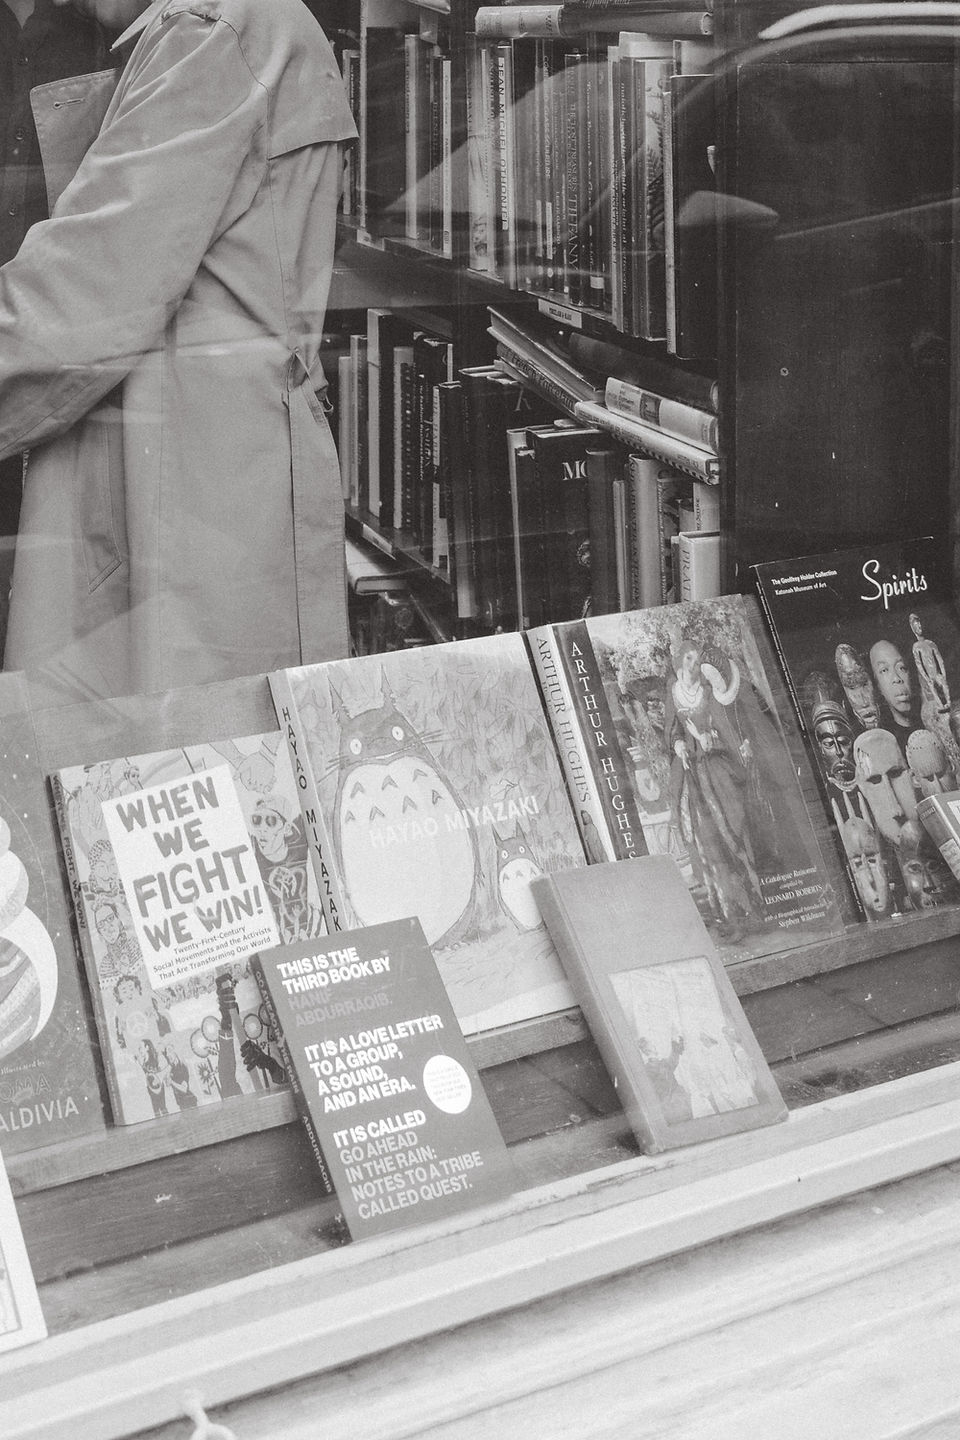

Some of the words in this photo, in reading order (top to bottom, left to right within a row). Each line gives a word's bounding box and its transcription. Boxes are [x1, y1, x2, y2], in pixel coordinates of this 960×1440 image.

[498, 64, 506, 96] JEAN
[499, 103, 507, 151] MICHEL
[771, 577, 781, 586] The
[814, 568, 838, 579] Collection
[793, 583, 813, 593] Museum
[819, 581, 827, 589] Art
[860, 559, 928, 610] Spirits
[571, 641, 607, 747] ARTHUR
[536, 637, 567, 714] ARTHUR
[558, 720, 591, 803] HUGHES
[115, 775, 221, 833] WHEN
[283, 707, 308, 790] HAYAO
[305, 809, 343, 932] MIYAZAK
[369, 816, 439, 849] HAYAO
[444, 795, 540, 833] MIYAZAKI
[153, 818, 210, 858] WE
[132, 844, 250, 918] FIGHT
[764, 890, 795, 905] LEONARD
[143, 912, 194, 953] WE
[192, 885, 264, 933] WIN!
[153, 957, 175, 972] Social
[175, 946, 215, 966] Movements
[215, 941, 229, 951] and
[229, 935, 242, 946] the
[242, 926, 272, 943] Activists
[159, 970, 175, 981] That
[176, 965, 188, 976] Are
[189, 949, 236, 971] Transforming
[236, 944, 249, 954] Our
[250, 936, 272, 950] World
[173, 925, 246, 956] Twenty-First-Century
[276, 956, 314, 979] THIS
[313, 953, 330, 971] IS
[327, 946, 360, 966] THE
[281, 970, 329, 995] THIRD
[328, 960, 374, 985] BOOK
[371, 956, 391, 975] BY
[289, 988, 333, 1011] HANIF
[304, 1043, 320, 1062] IT
[320, 1039, 338, 1058] IS
[339, 1036, 351, 1054] A
[348, 1026, 390, 1050] LOVE
[388, 1014, 444, 1041] LETTER
[309, 1059, 334, 1078] TO
[335, 1056, 348, 1073] A
[346, 1042, 403, 1069] GROUP,
[318, 1079, 331, 1096] A
[329, 1065, 389, 1092] SOUND,
[324, 1090, 357, 1114] AND
[358, 1083, 382, 1104] AN
[379, 1075, 417, 1098] ERA.
[332, 1129, 349, 1149] IT
[349, 1124, 368, 1144] IS
[367, 1109, 427, 1138] CALLED
[339, 1146, 365, 1165] GO
[366, 1131, 419, 1158] AHEAD
[344, 1164, 364, 1184] IN
[362, 1156, 397, 1178] THE
[395, 1144, 438, 1169] RAIN:
[350, 1172, 406, 1202] NOTES
[404, 1166, 428, 1185] TO
[428, 1163, 441, 1180] A
[439, 1150, 485, 1176] TRIBE
[357, 1188, 420, 1220] CALLED
[420, 1173, 473, 1201] QUEST.
